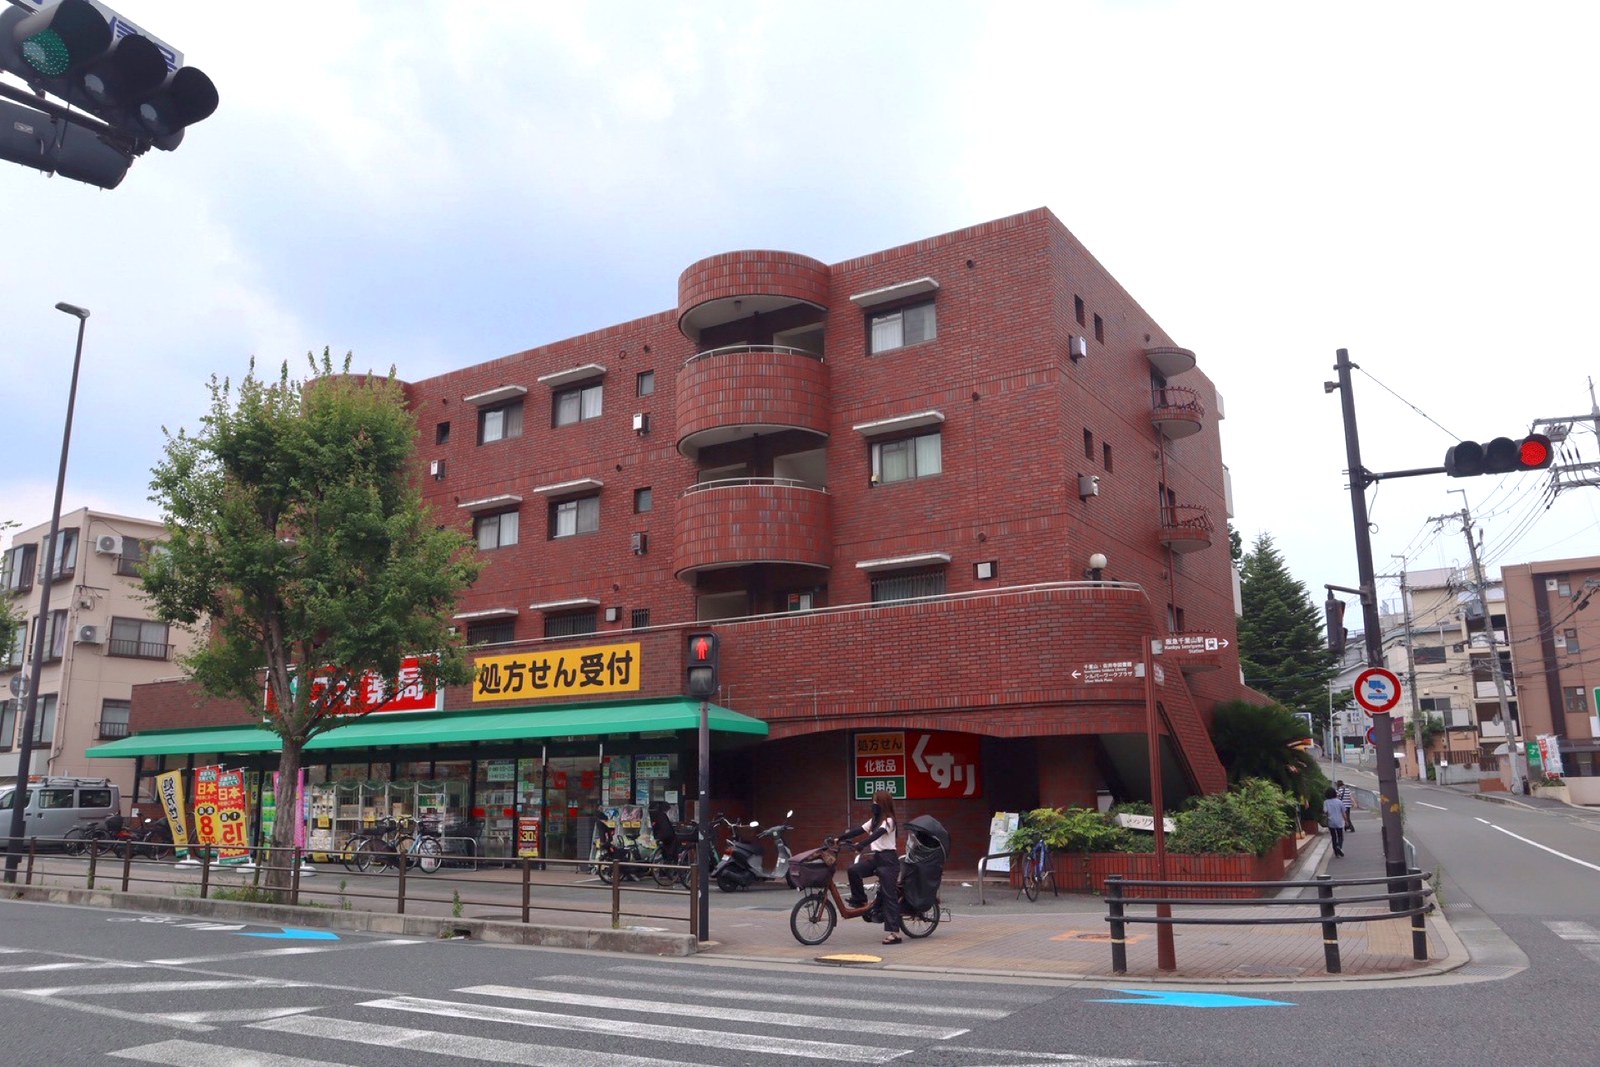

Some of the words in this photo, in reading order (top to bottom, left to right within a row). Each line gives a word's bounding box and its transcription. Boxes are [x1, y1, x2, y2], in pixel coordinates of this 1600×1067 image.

[479, 650, 633, 694] 処方せん受付
[1084, 671, 1133, 679] シルバーワークプラザ
[857, 738, 903, 752] 処方せん
[864, 759, 896, 773] 化粧品
[911, 734, 976, 796] くすり
[864, 780, 897, 795] 日用品
